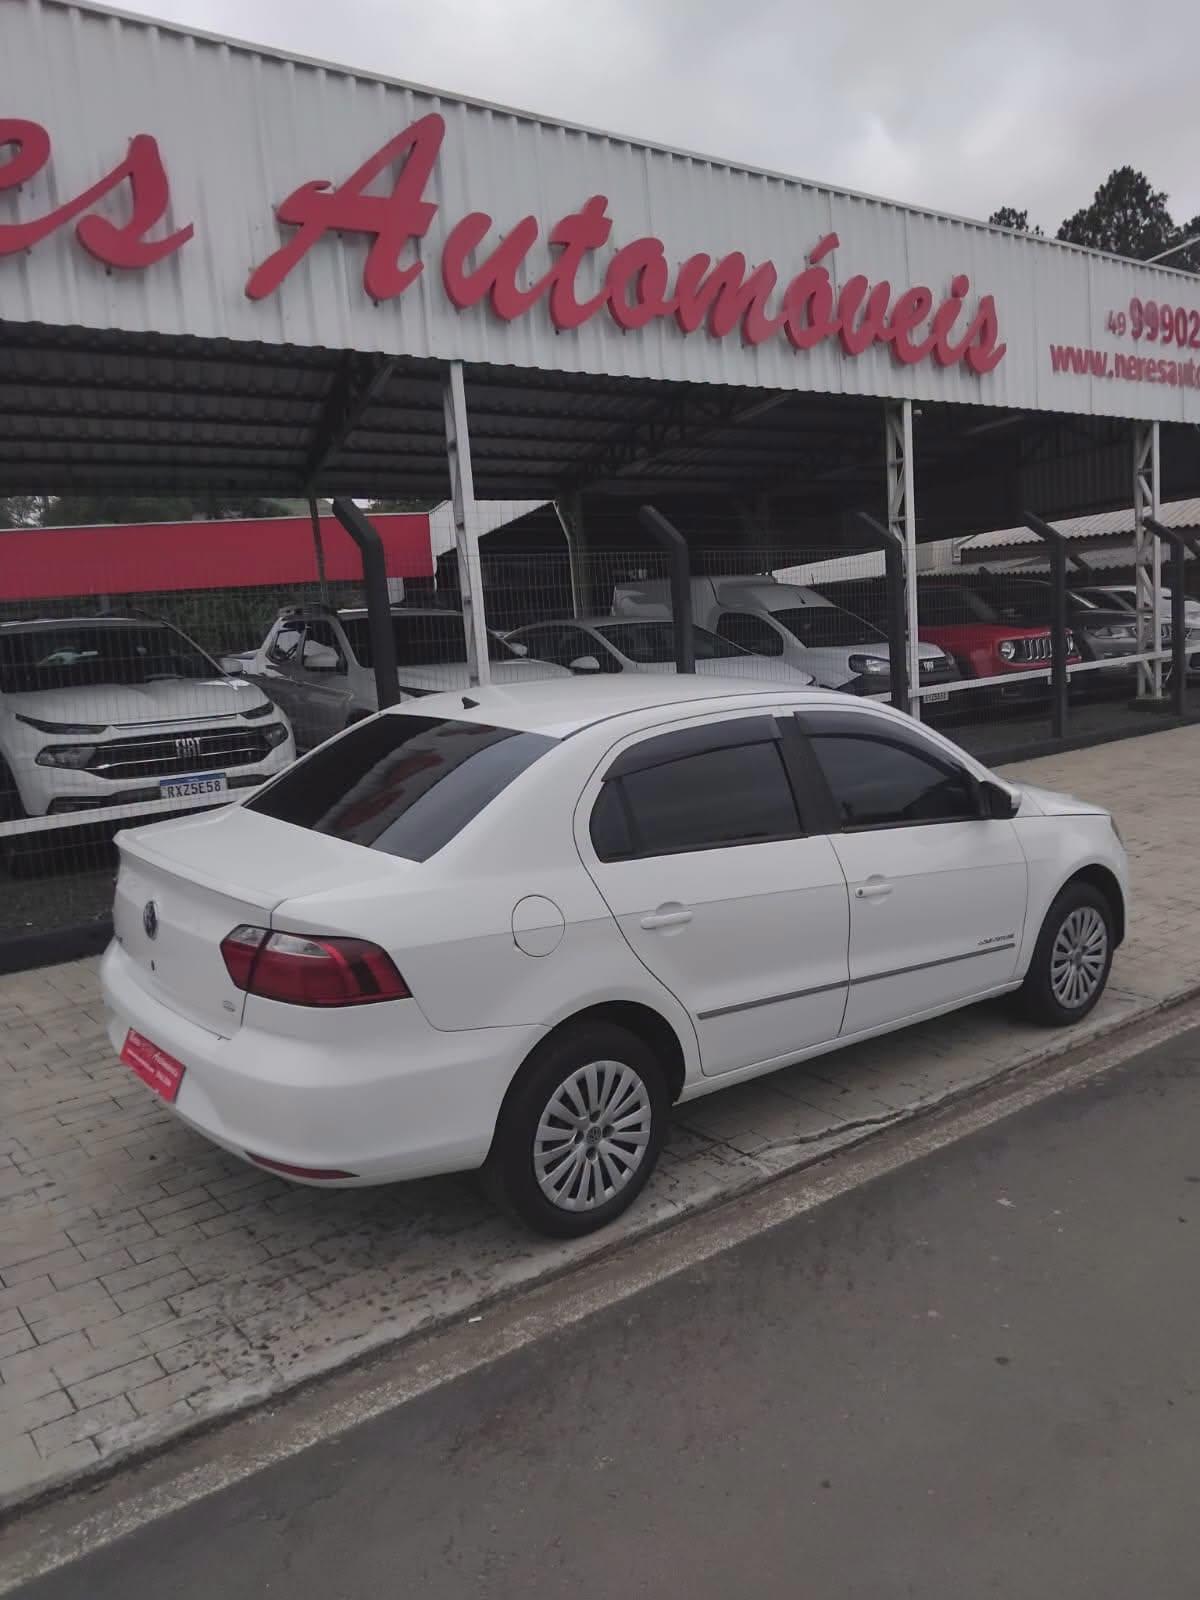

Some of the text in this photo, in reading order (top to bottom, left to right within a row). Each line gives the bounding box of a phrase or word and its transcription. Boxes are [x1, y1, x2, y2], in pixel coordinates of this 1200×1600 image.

[245, 113, 1006, 374] Automóveis
[1108, 310, 1126, 336] 49
[176, 737, 201, 758] FIAT
[167, 780, 221, 798] RXZ5E58
